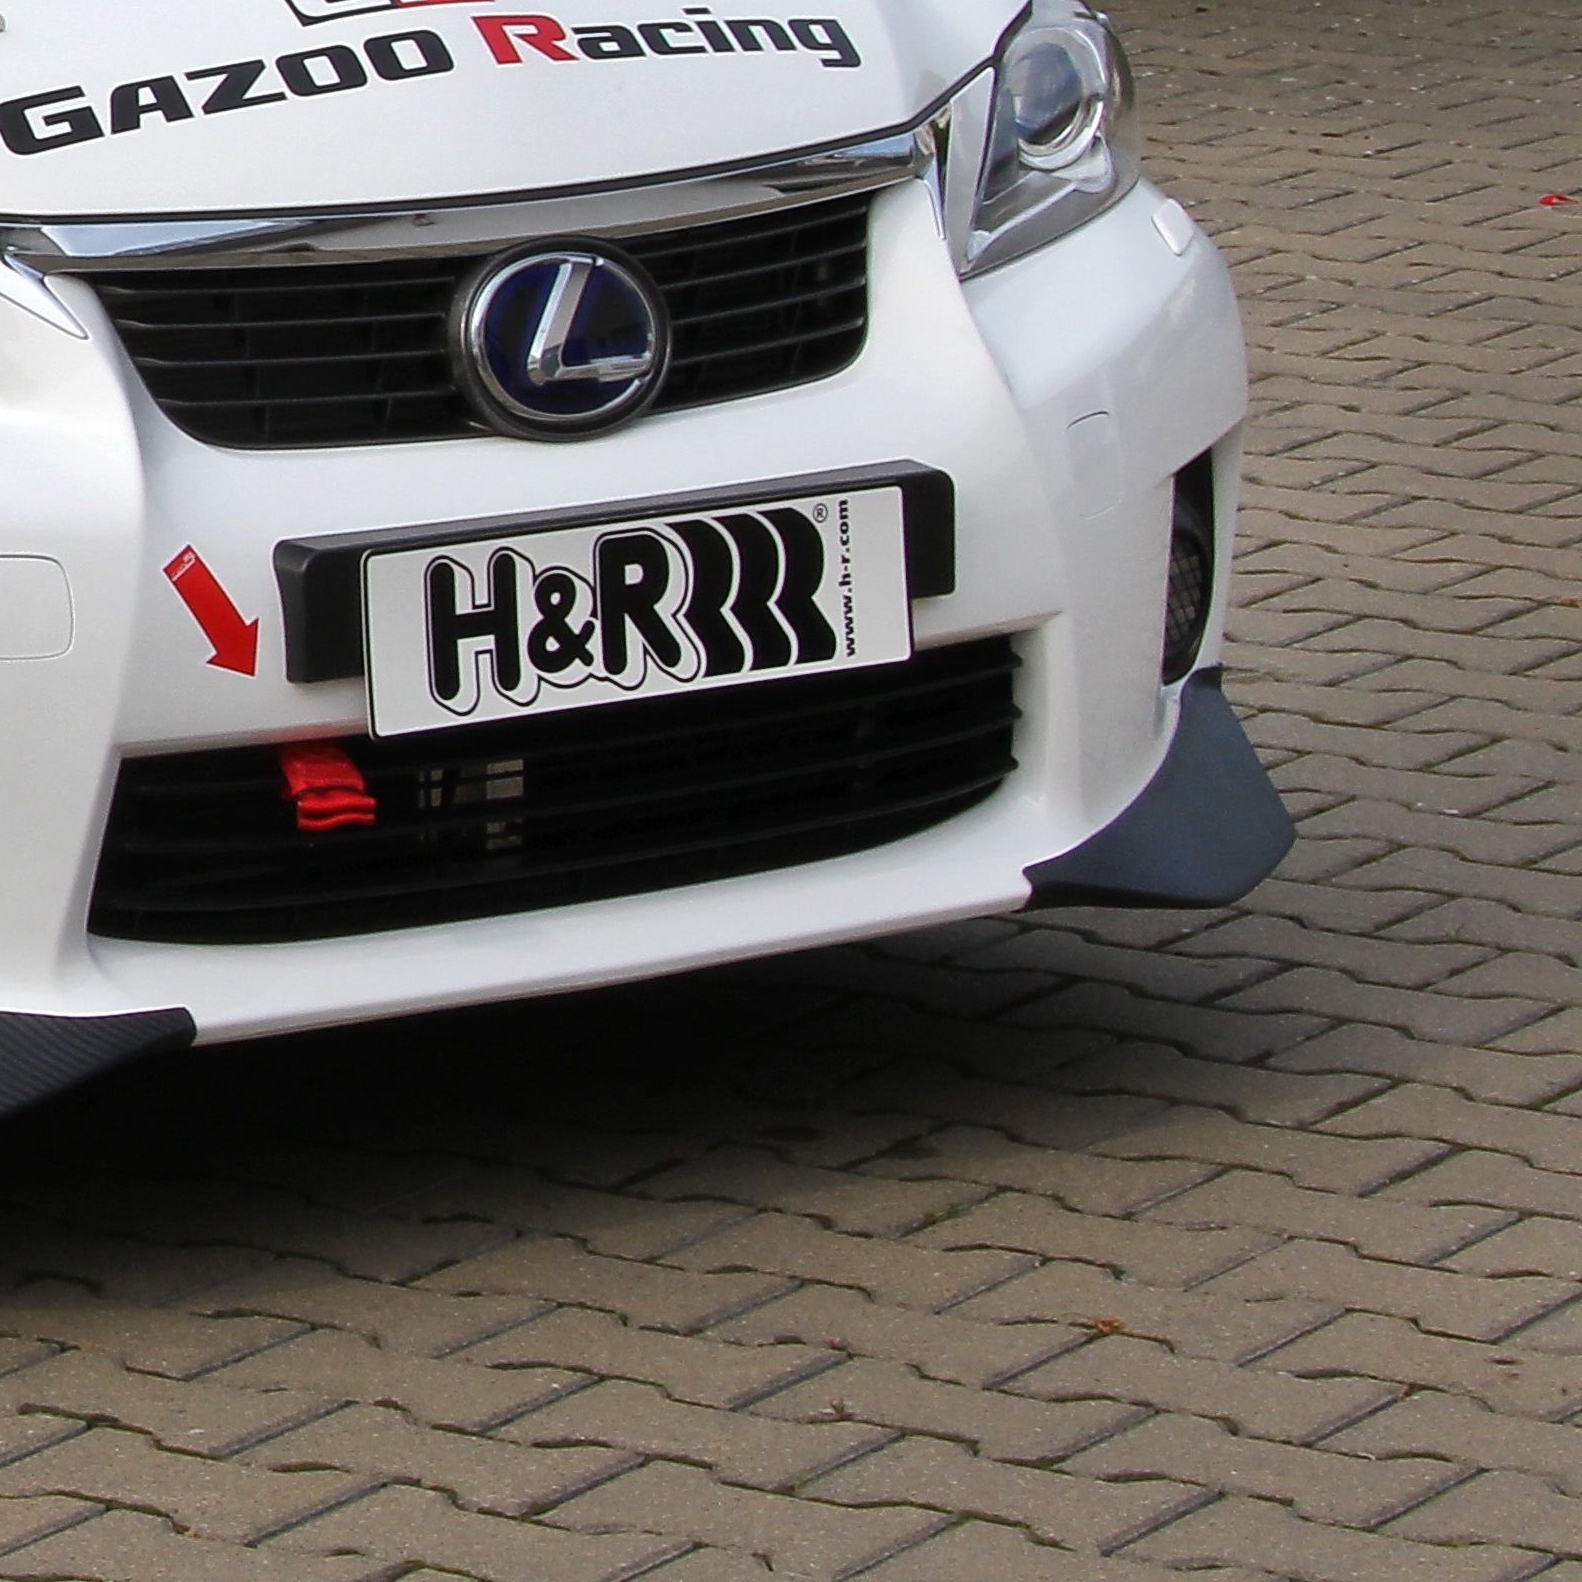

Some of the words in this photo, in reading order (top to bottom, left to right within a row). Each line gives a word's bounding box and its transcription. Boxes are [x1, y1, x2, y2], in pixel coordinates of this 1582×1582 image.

[471, 6, 863, 68] Racing
[424, 525, 702, 716] H&R
[838, 499, 856, 658] www.h-r.com
